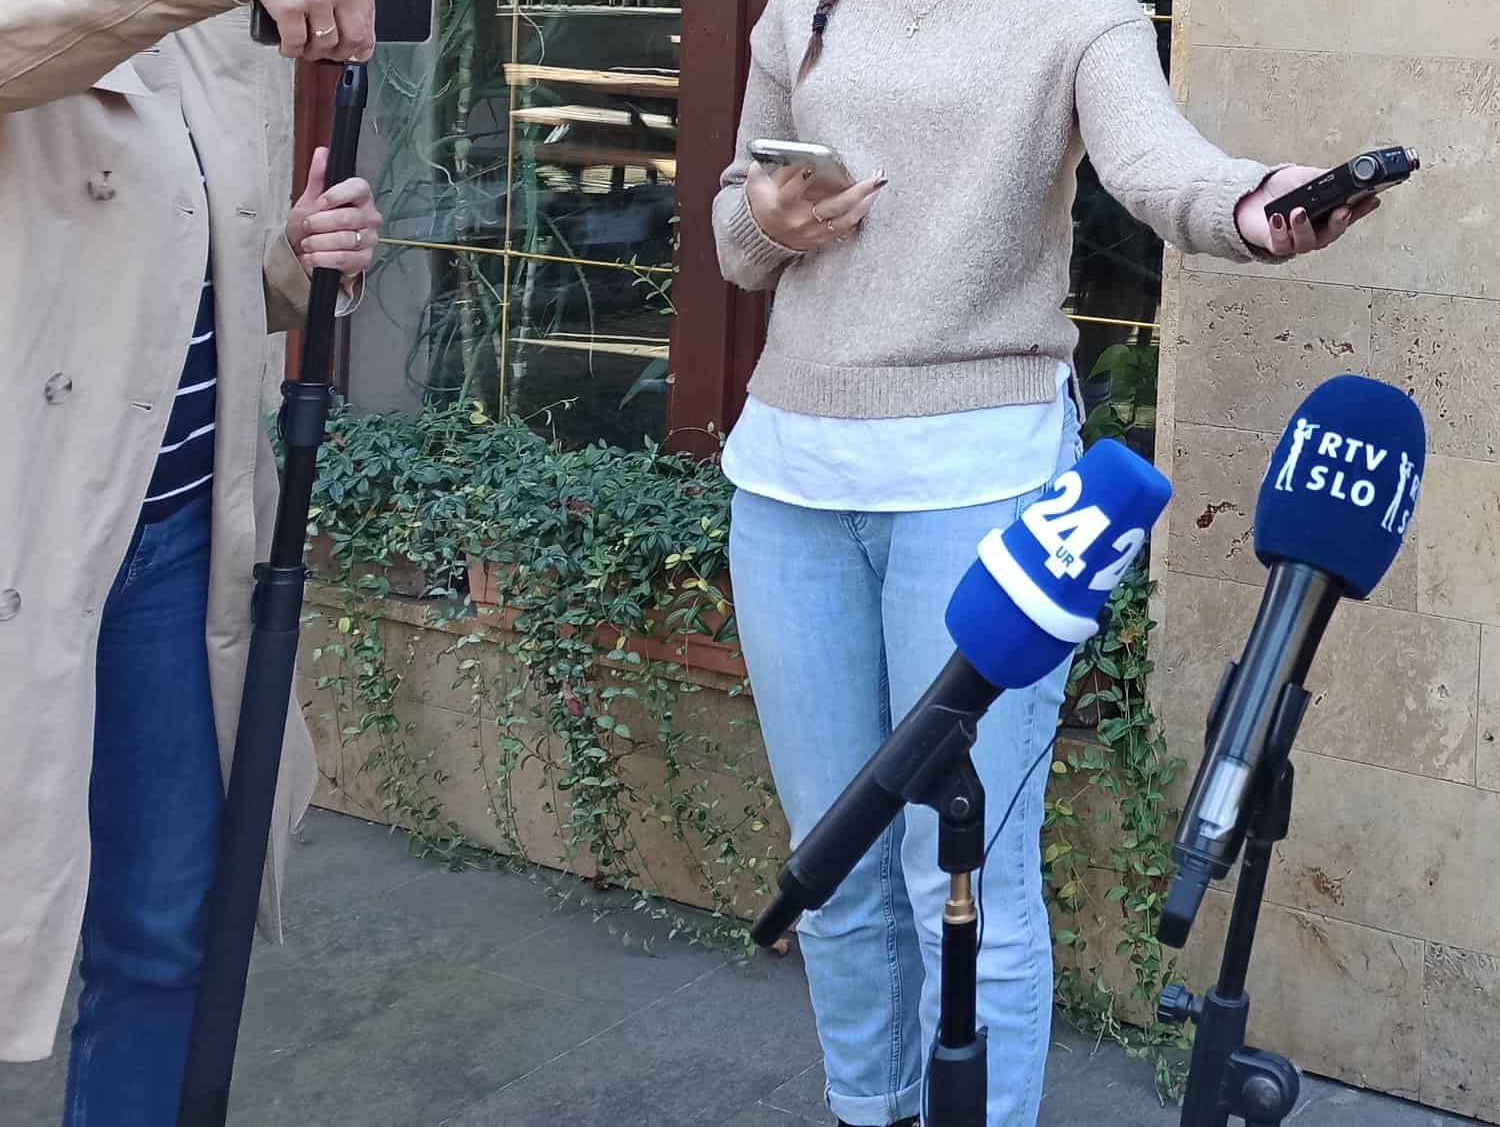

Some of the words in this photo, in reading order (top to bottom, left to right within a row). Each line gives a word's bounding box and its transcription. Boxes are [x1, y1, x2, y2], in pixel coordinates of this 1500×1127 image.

[1318, 432, 1388, 471] RTV
[1306, 465, 1375, 506] SLO
[1021, 471, 1111, 580] 24
[1055, 545, 1075, 568] UR
